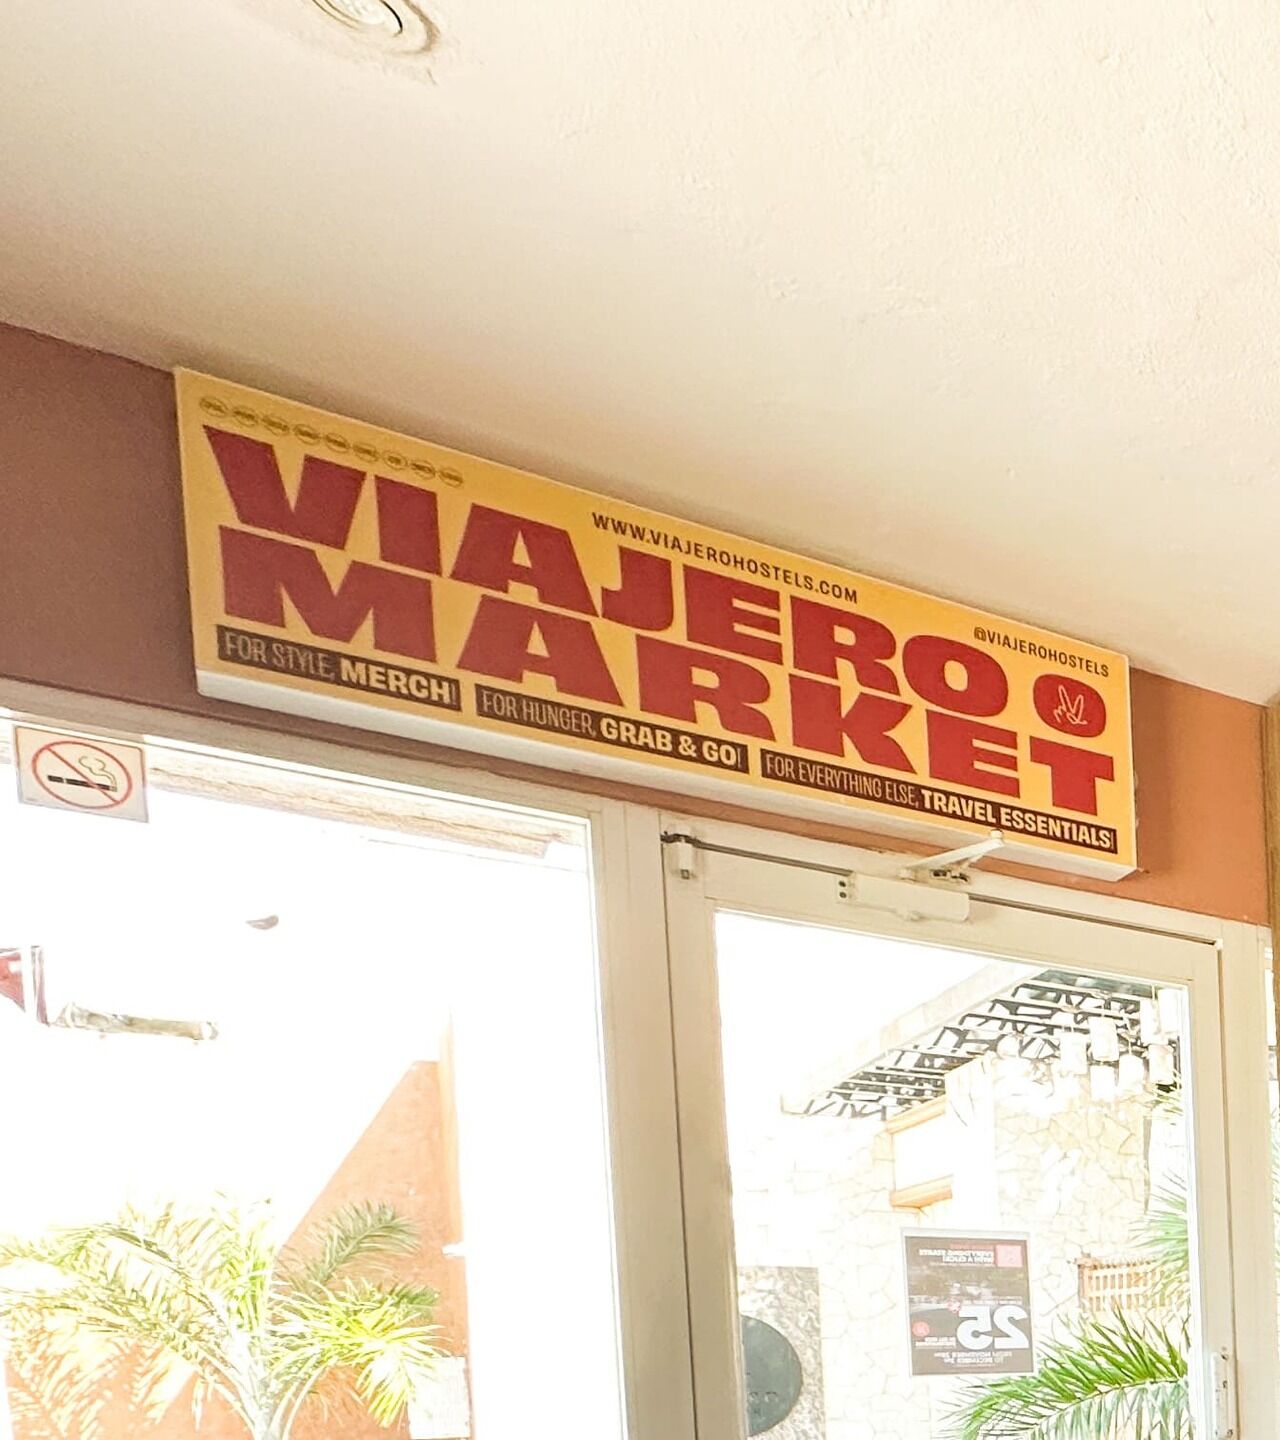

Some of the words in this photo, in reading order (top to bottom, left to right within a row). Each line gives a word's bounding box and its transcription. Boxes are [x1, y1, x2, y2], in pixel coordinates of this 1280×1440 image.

[202, 424, 1008, 717] VIAJERO
[592, 511, 858, 605] WWW.VIAJEROHOSTELS.COM
[218, 524, 1115, 816] MARKET
[225, 632, 267, 663] FOR
[974, 626, 1110, 678] @VIAJEROHOSTELS
[482, 689, 518, 719] FOR
[600, 717, 673, 752] GRAB
[678, 735, 697, 758] &
[766, 754, 796, 780] FOR
[798, 761, 883, 799] EVERYTHING
[921, 789, 997, 824] TRAVEL
